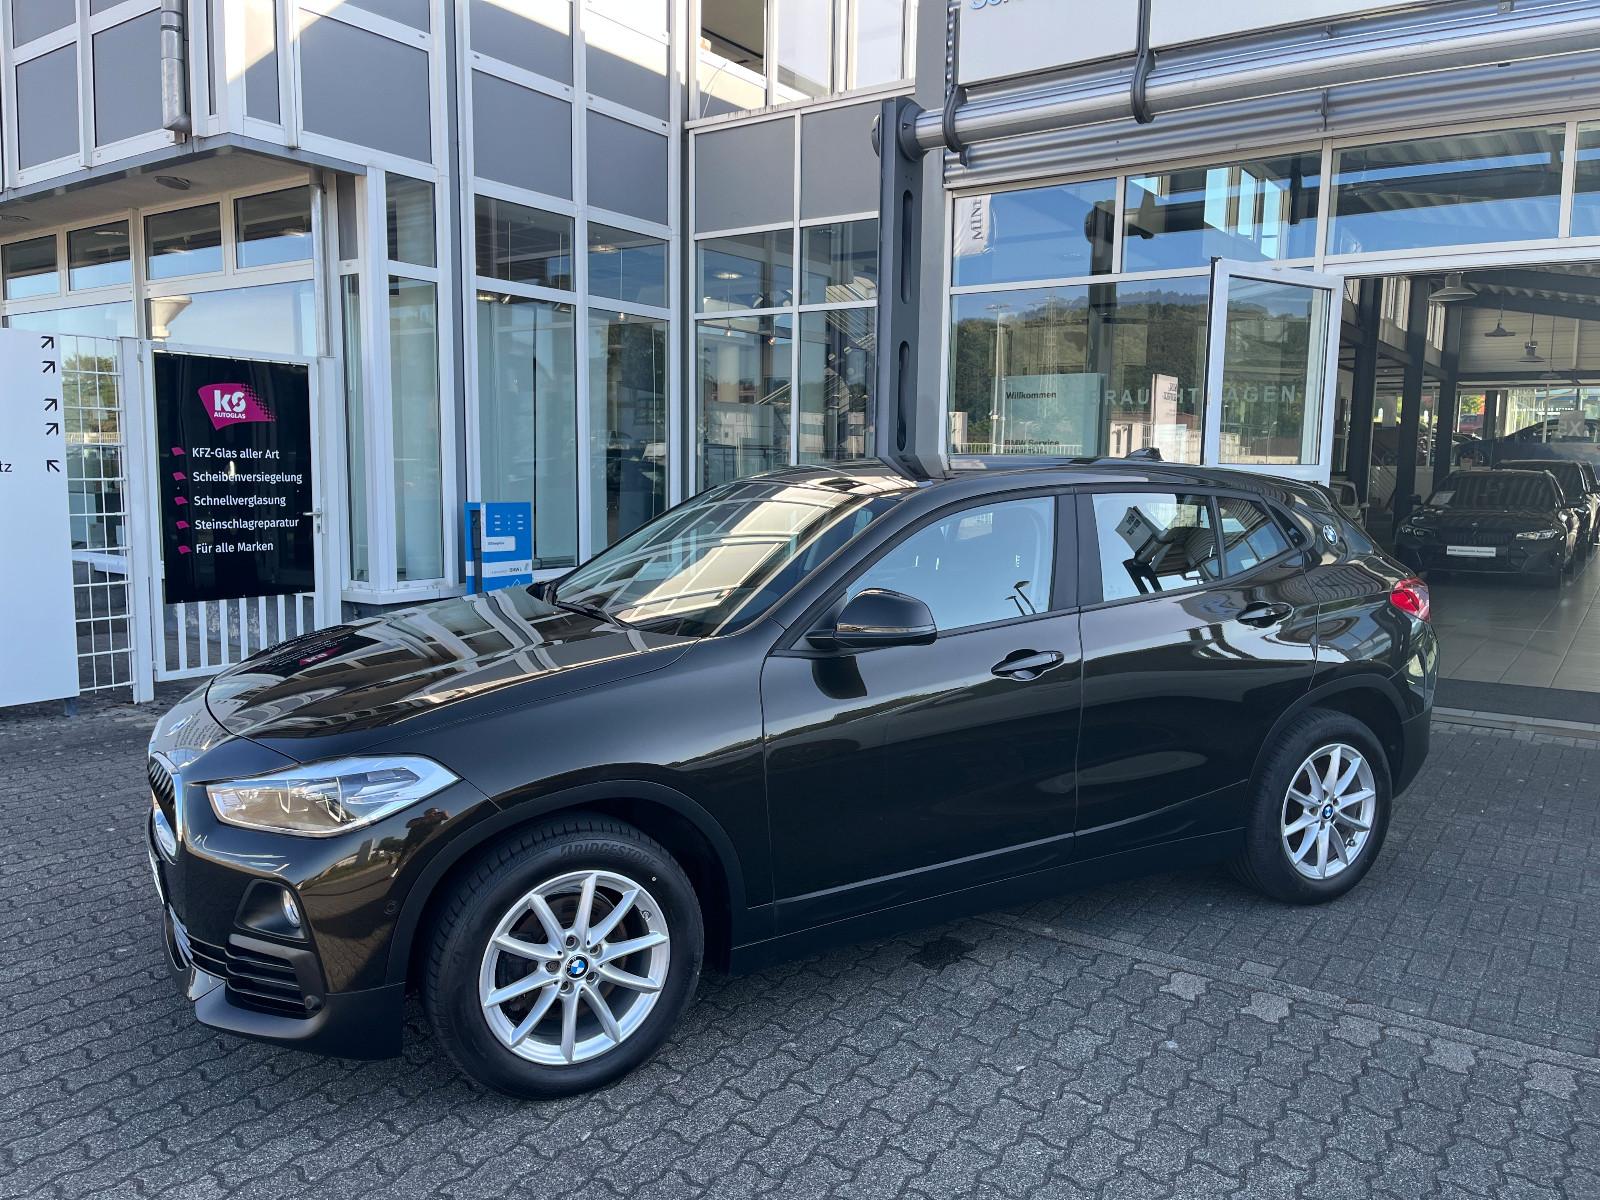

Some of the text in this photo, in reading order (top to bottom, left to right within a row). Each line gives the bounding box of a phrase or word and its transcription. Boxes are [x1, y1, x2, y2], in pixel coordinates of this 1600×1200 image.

[1005, 391, 1057, 400] Willkommen
[213, 411, 247, 419] AUTOGLAS
[192, 447, 280, 459] KFZ-Glas aller Art
[192, 471, 303, 484] Scheibenversiegelung
[193, 495, 287, 507] Schnellverglasung
[194, 518, 300, 531] Steinschlagreparatur
[196, 541, 274, 554] Für alle Marken
